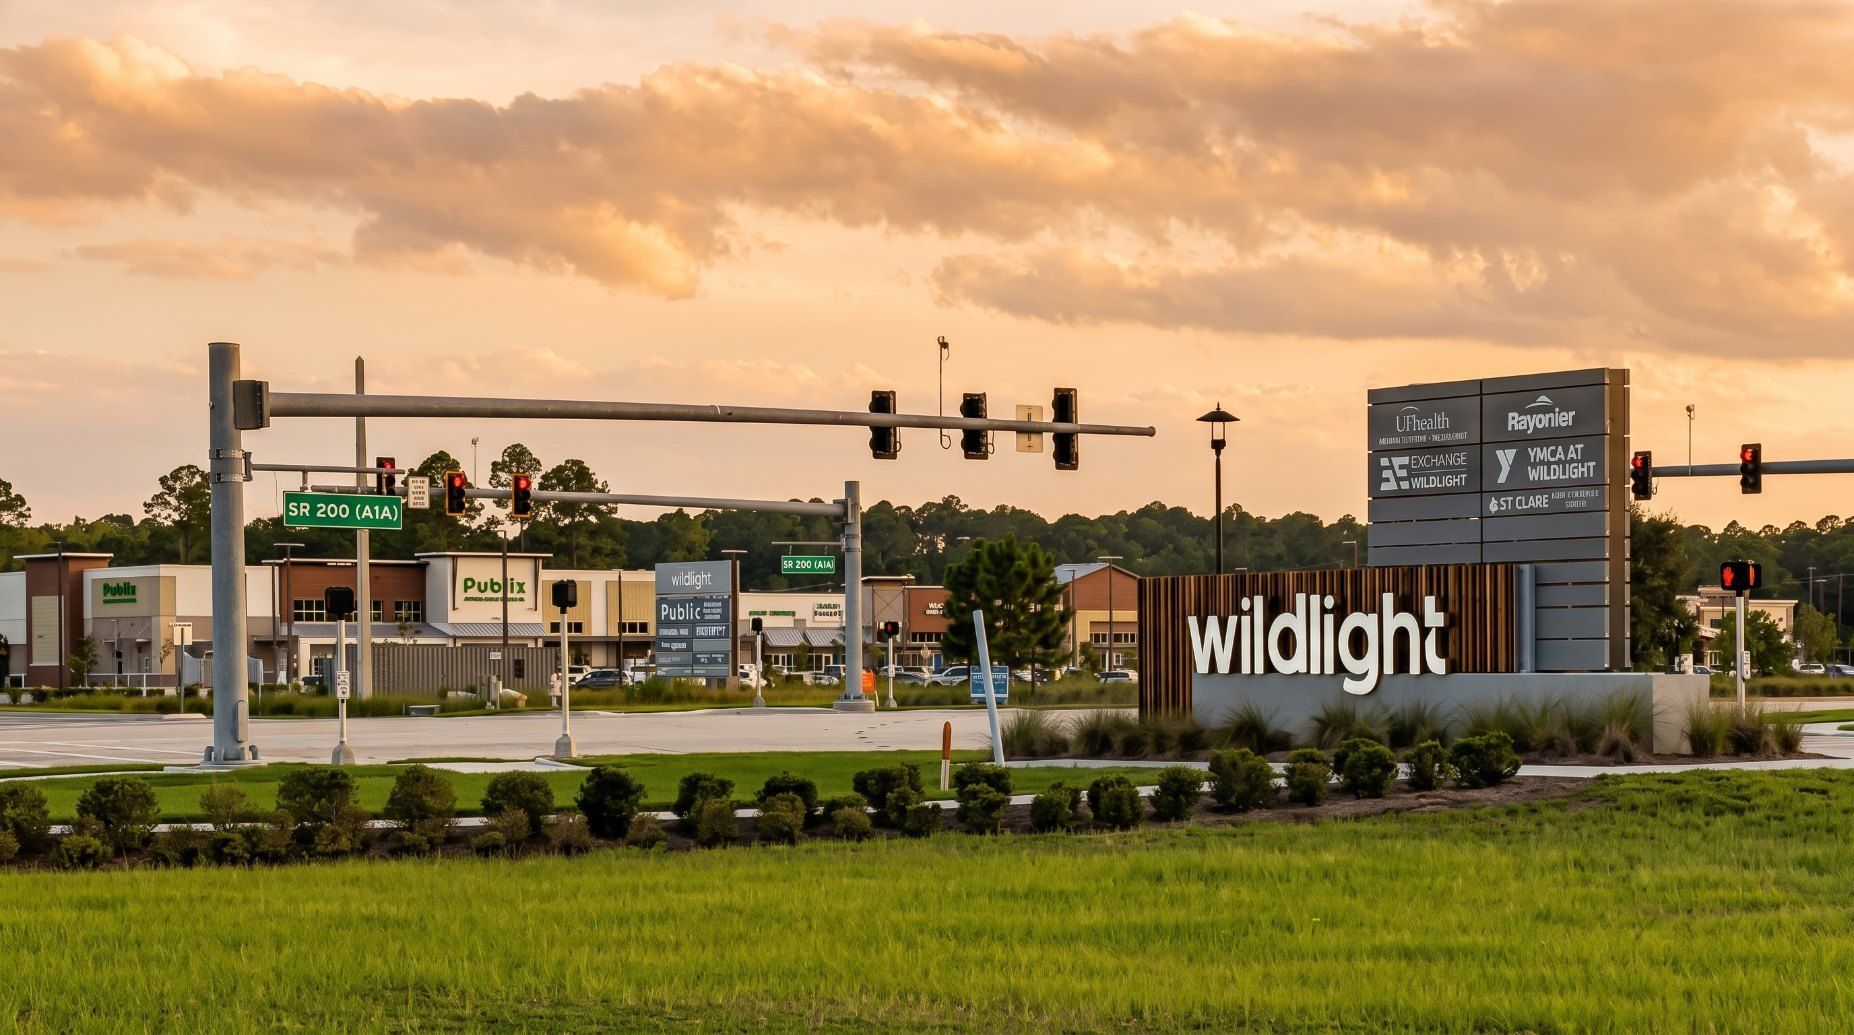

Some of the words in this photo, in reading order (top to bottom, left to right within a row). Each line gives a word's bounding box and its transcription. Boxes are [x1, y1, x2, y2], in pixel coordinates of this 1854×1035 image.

[1507, 407, 1576, 434] Rayonier
[1411, 452, 1467, 469] EXCHANGE
[1527, 445, 1565, 462] YMCA
[1567, 444, 1584, 460] AT
[1527, 462, 1596, 481] WILDLIGHT
[1411, 474, 1467, 489] WILDLIGHT
[1499, 496, 1514, 510] ST
[1515, 494, 1549, 509] CLARE
[288, 502, 310, 517] SR
[316, 503, 350, 518] 200
[355, 504, 398, 521] (A1A)
[783, 560, 793, 569] SR
[795, 560, 812, 569] 200
[463, 577, 526, 594] Pubix
[671, 571, 712, 590] wildlight
[661, 603, 701, 621] Public
[1187, 592, 1446, 696] wildlight
